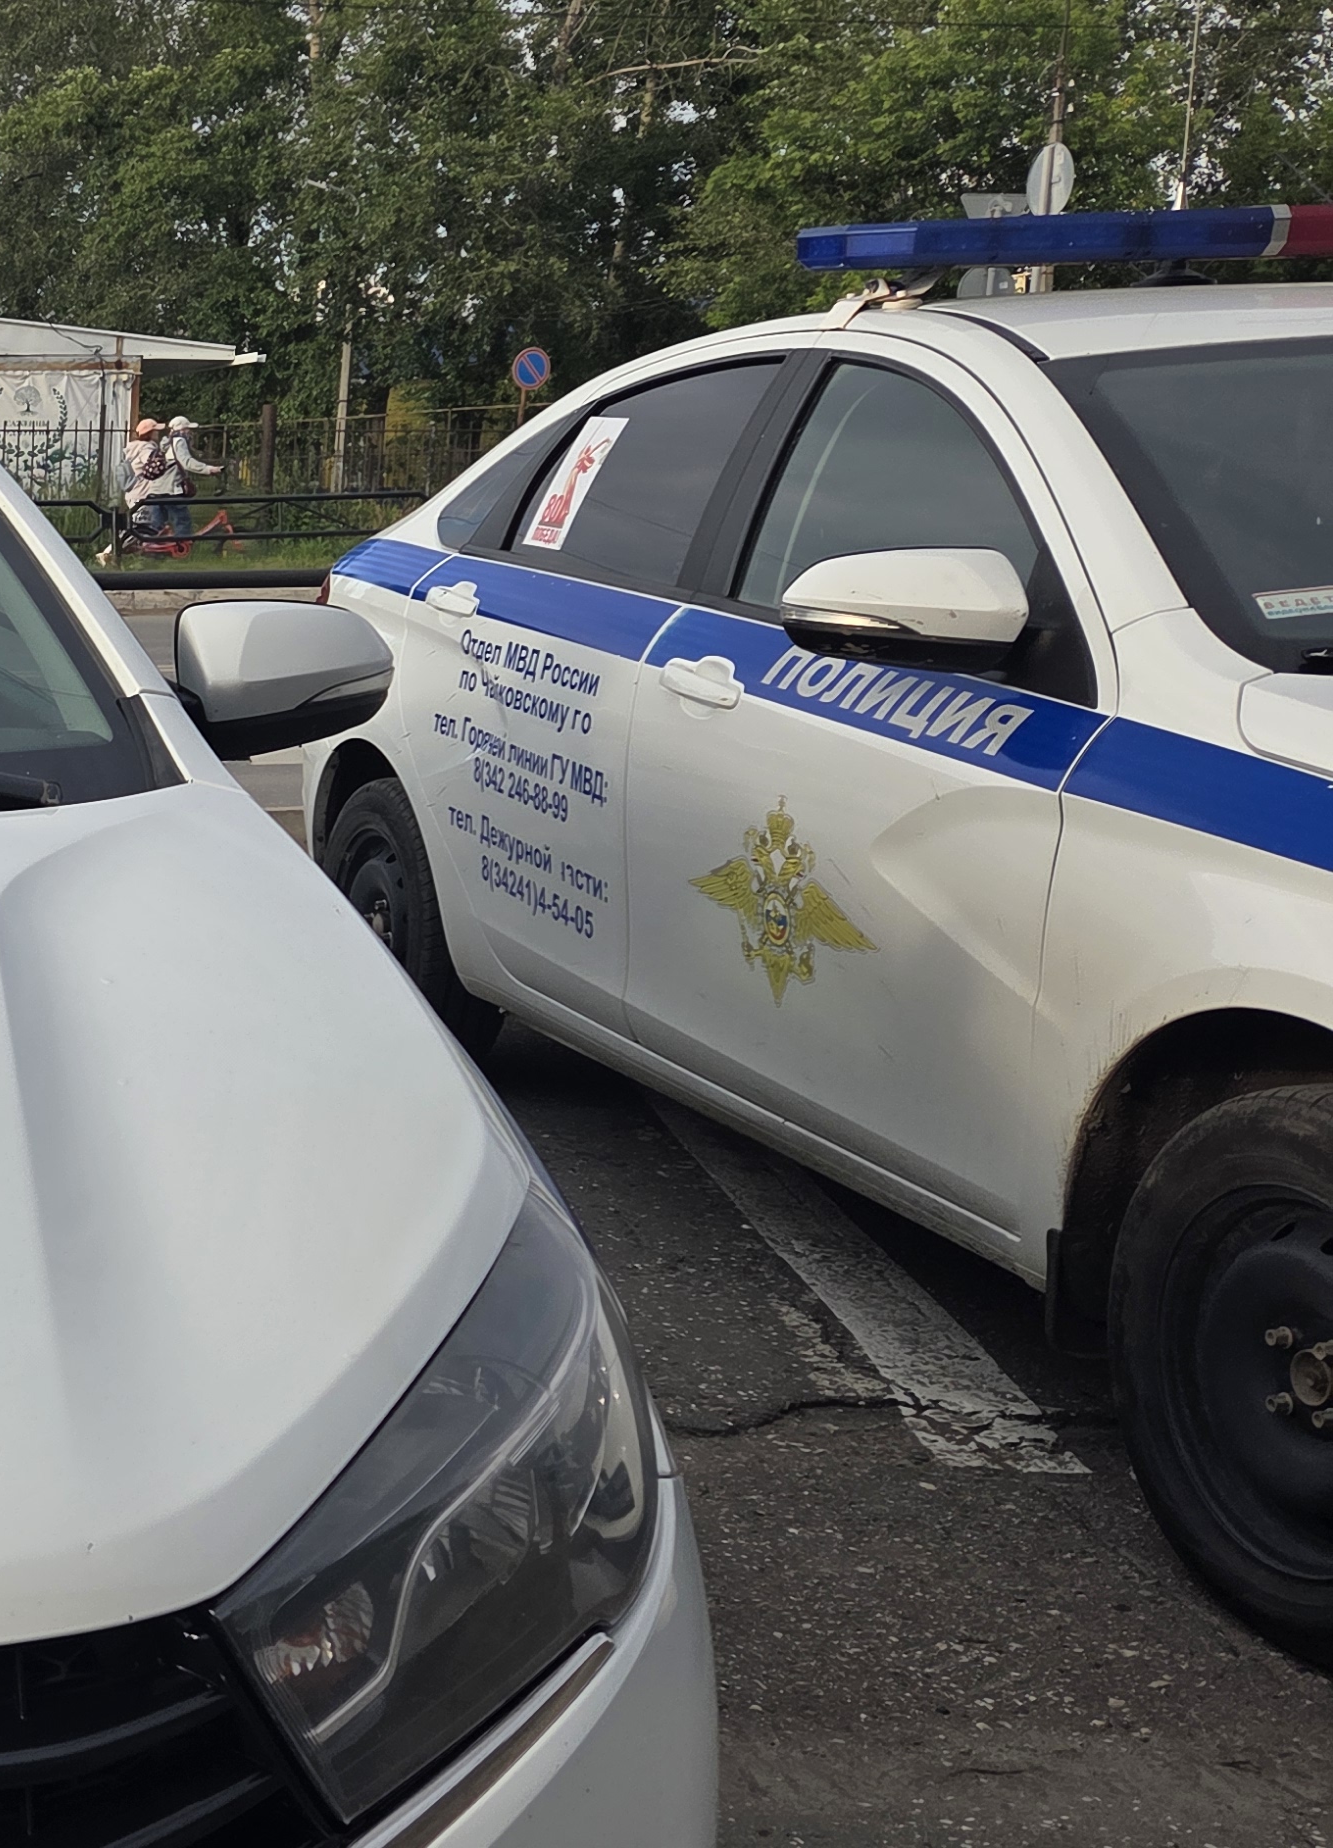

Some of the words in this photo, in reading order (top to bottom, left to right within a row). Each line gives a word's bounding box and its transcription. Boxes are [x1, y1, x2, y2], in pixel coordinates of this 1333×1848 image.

[459, 670, 477, 692] по
[481, 667, 570, 733] Чайковскому
[460, 629, 502, 665] Отдел
[503, 641, 540, 683] МВД
[540, 652, 600, 696] России
[761, 645, 1035, 756] ПОЛИЦИЯ
[434, 713, 458, 739] тел.
[461, 716, 506, 760] Горячей
[507, 744, 549, 779] линии
[549, 753, 570, 785] ГУ
[570, 761, 608, 808] МВД:
[448, 806, 477, 835] тел.
[479, 814, 552, 874] Дежурной
[481, 855, 594, 939] 8(34241)4-54-05
